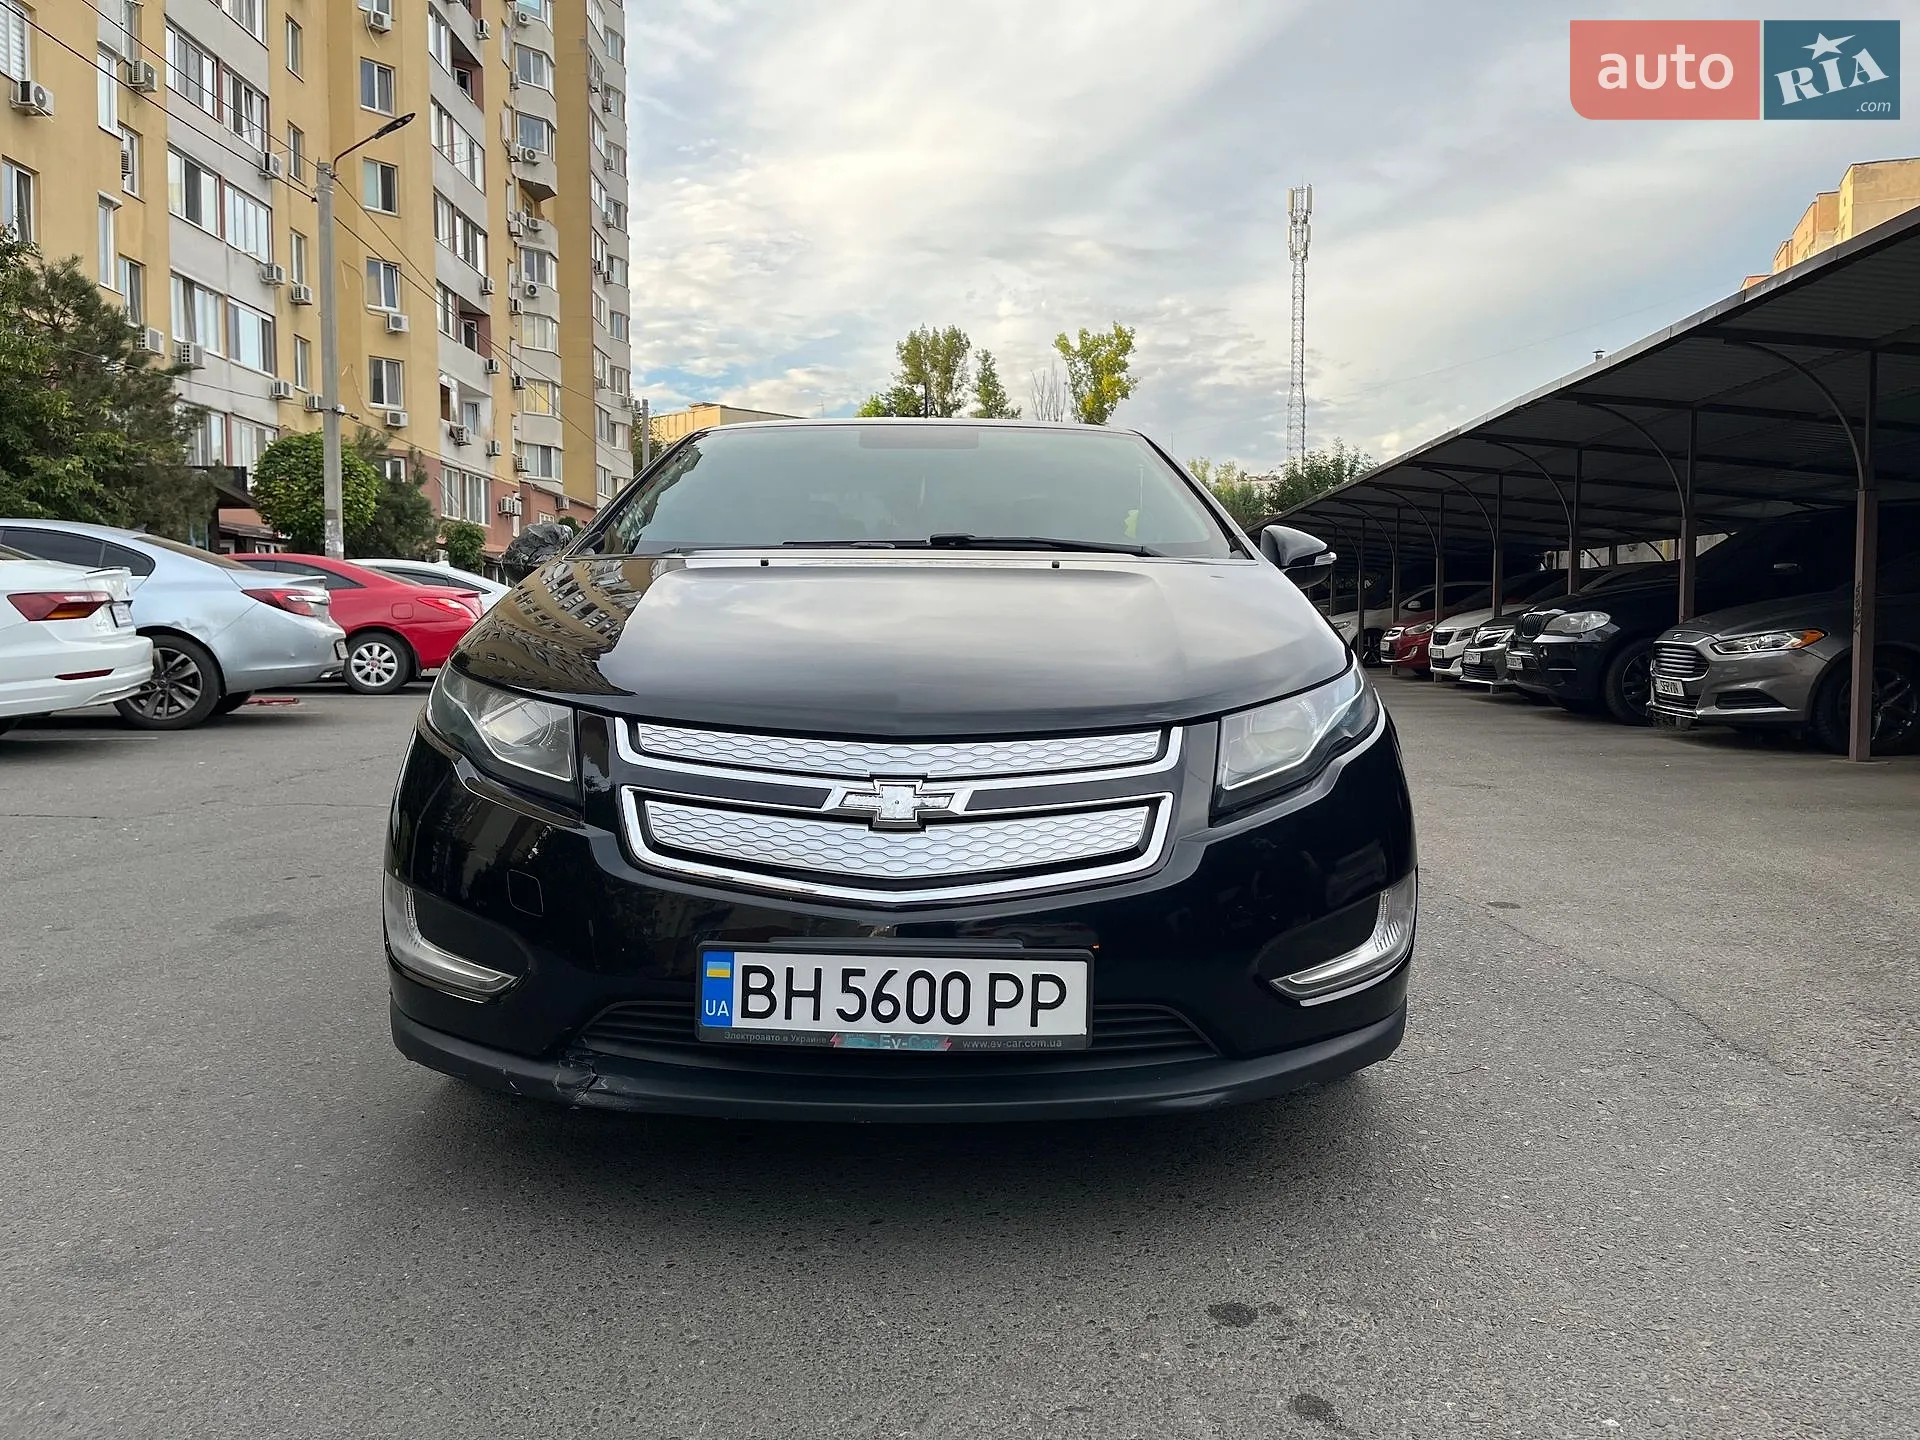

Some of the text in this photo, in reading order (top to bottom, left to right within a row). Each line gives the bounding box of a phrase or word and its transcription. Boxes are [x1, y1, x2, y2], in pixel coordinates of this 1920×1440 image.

[740, 964, 1067, 1027] BH 5600 PP
[705, 999, 730, 1017] UA
[724, 1031, 780, 1043] Электроавто
[962, 1038, 1062, 1048] www.ev-car.com.ua
